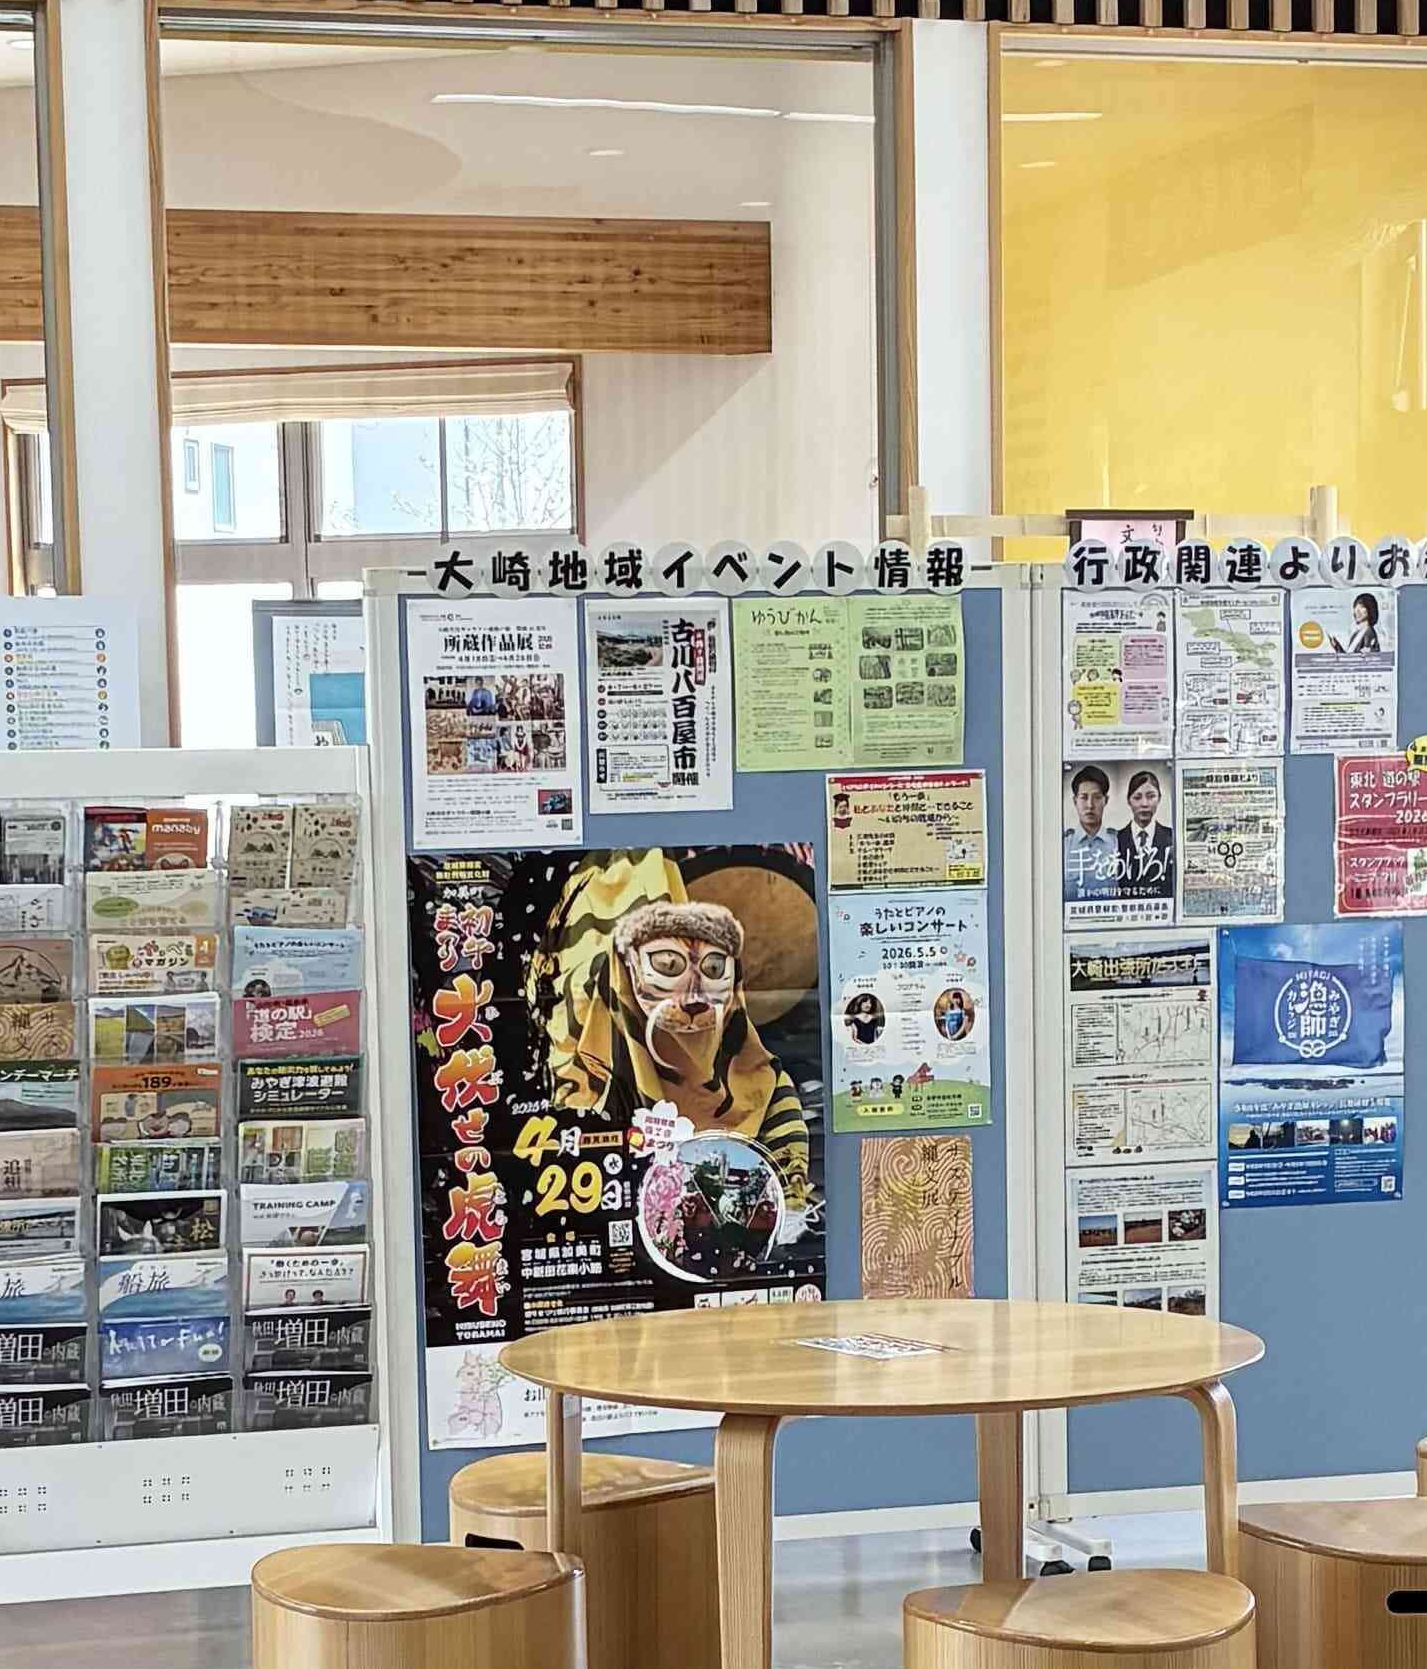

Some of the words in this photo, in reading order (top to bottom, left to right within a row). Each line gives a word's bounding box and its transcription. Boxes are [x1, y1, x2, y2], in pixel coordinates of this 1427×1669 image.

[433, 549, 965, 591] 大崎地域イベント情報
[751, 607, 823, 626] ゆうびかん
[443, 633, 534, 653] 所蔵作品展
[671, 617, 698, 771] 古川八百屋市
[1350, 771, 1377, 789] 東北
[875, 906, 946, 921] うたとピアノの
[859, 919, 968, 937] 楽しいコンサート
[881, 946, 937, 960] 2026.5.5
[513, 1115, 583, 1168] 4月
